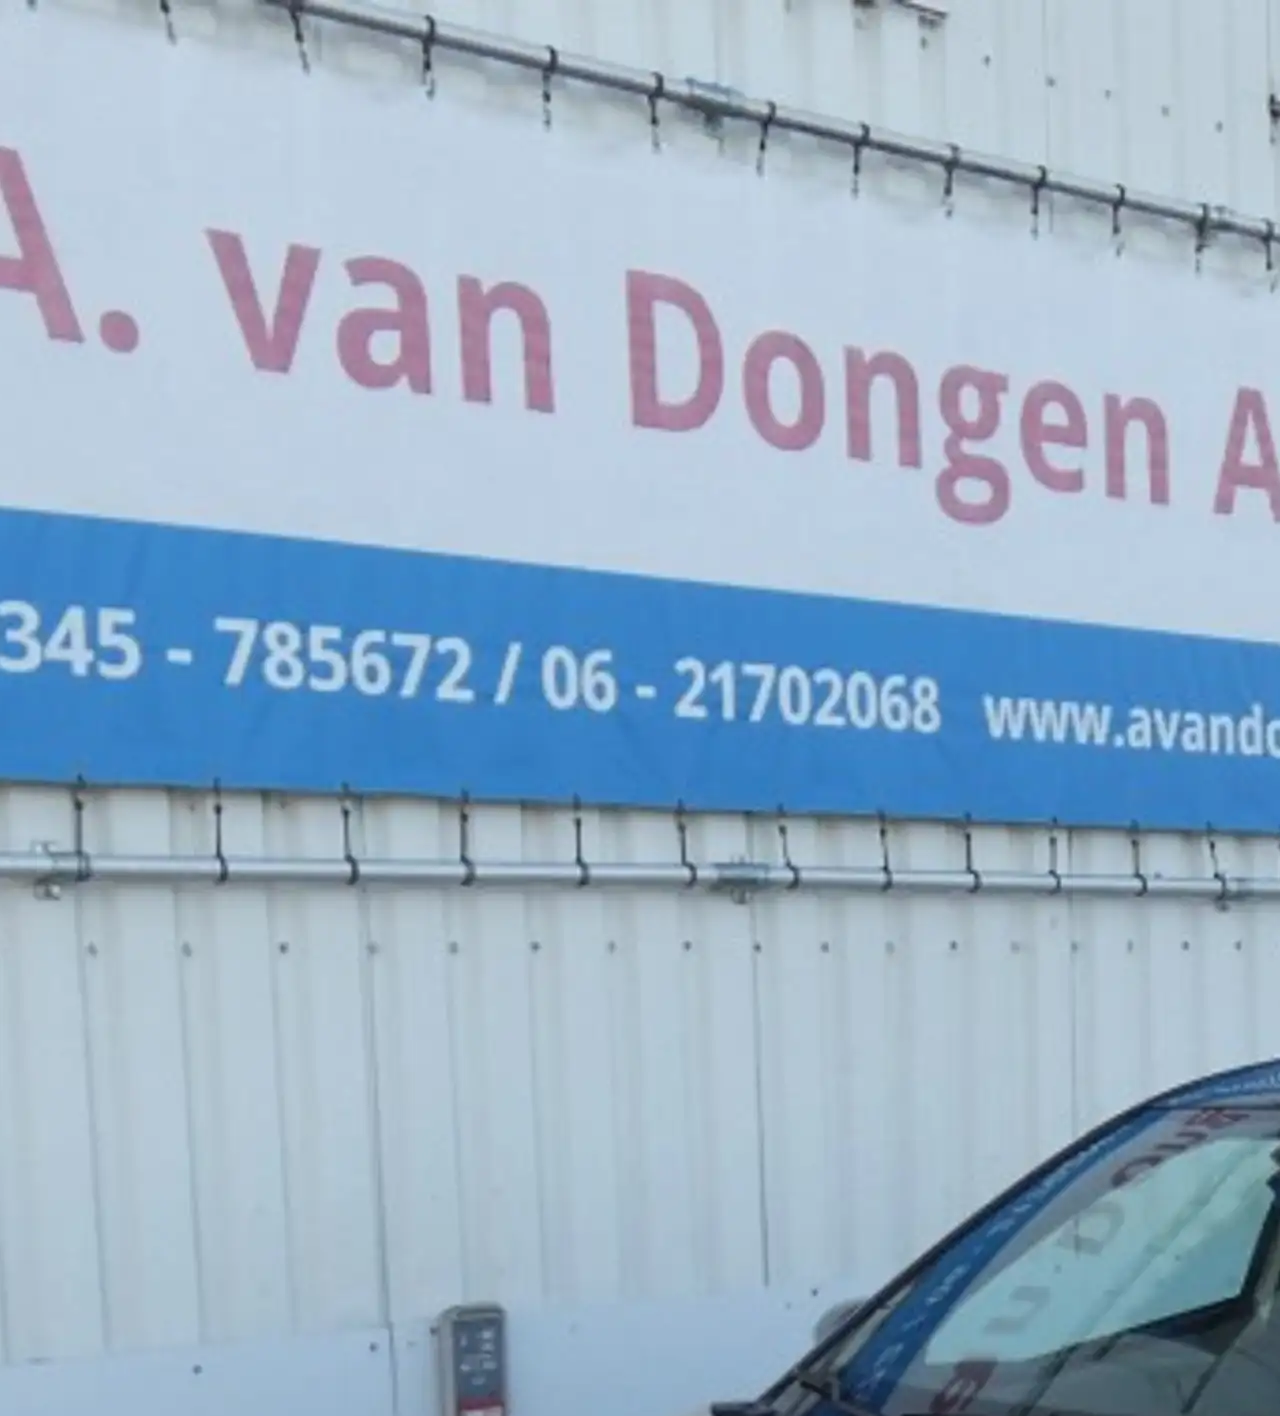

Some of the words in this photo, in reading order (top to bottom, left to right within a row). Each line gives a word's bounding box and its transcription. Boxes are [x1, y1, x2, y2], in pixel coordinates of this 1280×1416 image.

[202, 226, 556, 414] van
[624, 268, 1171, 526] Dongen
[212, 615, 474, 704] 785672
[494, 641, 523, 706] /
[540, 645, 617, 712] 06
[673, 655, 941, 734] 21702068
